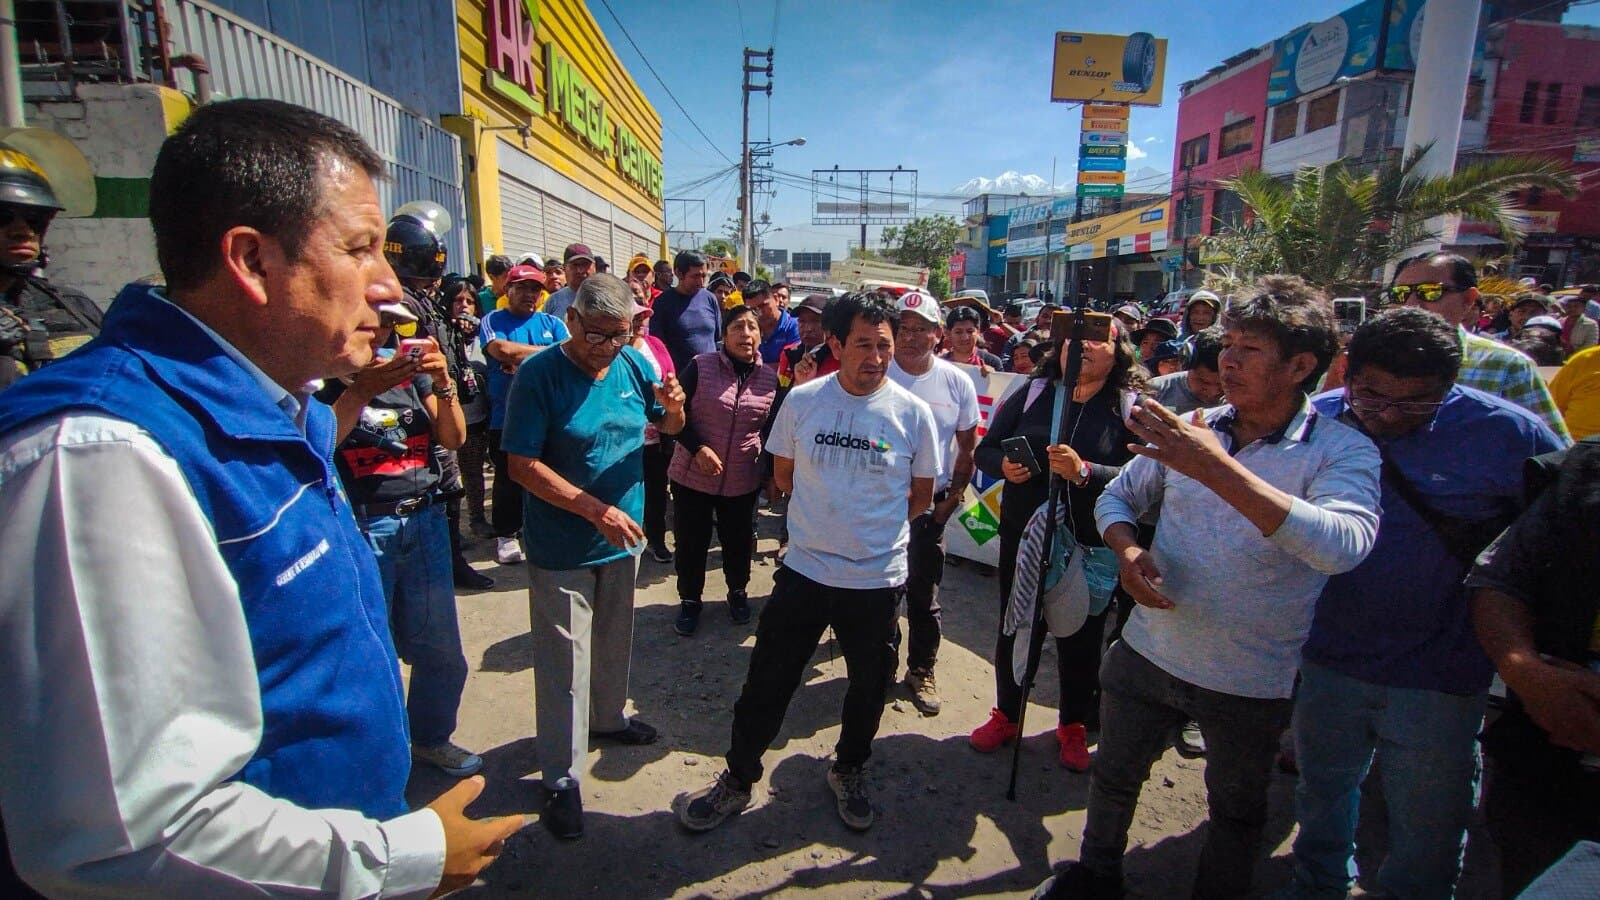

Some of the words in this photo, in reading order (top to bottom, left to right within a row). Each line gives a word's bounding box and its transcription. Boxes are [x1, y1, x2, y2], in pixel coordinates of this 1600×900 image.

[1069, 69, 1112, 79] DUNLOP
[545, 42, 611, 159] MEGA
[616, 124, 665, 206] CENTER
[1071, 224, 1102, 237] DUNLOP
[814, 432, 871, 451] adidas
